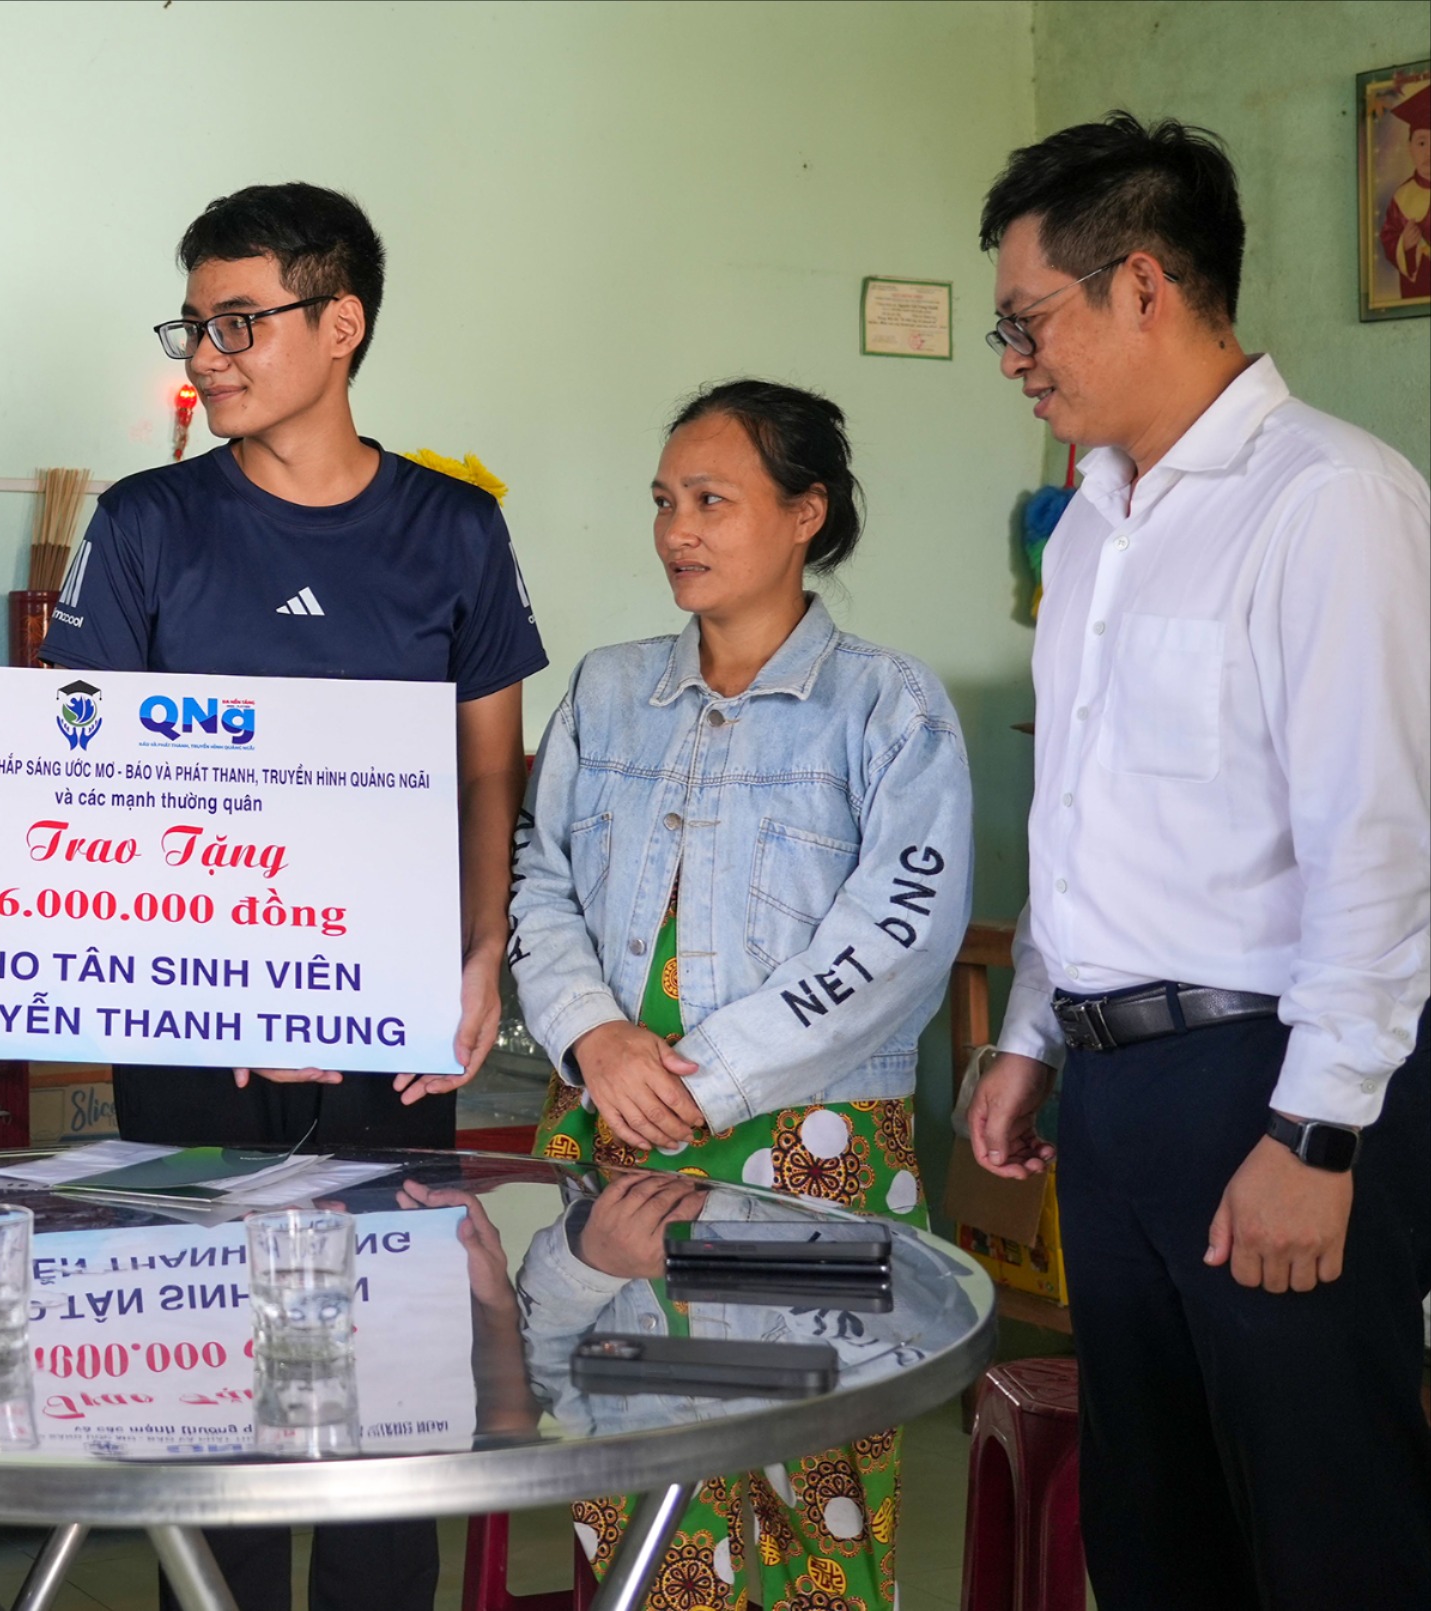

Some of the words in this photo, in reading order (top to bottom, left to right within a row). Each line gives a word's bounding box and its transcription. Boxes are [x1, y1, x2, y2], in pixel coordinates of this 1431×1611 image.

[139, 695, 255, 745] QNg
[25, 756, 62, 777] SÁNG
[65, 758, 92, 778] ƯỚC
[95, 761, 115, 779] MƠ
[125, 760, 153, 780] BÁO
[155, 761, 172, 781] VÀ
[175, 762, 209, 782] PHÁT
[212, 766, 259, 786] THANH,
[262, 763, 313, 786] TRUYỀN
[316, 766, 347, 787] HÌNH
[350, 765, 396, 789] QUẢNG
[399, 770, 430, 789] NGÃI
[54, 787, 73, 805] và
[78, 788, 106, 806] các
[111, 790, 156, 811] mạnh
[160, 791, 218, 815] thường
[222, 794, 263, 815] quân
[26, 819, 141, 865] Trao
[161, 824, 288, 879] Tặng
[231, 887, 348, 937] đồng
[780, 945, 874, 1028] NET
[874, 845, 945, 949] DNG
[52, 946, 135, 984] TÂN
[150, 955, 249, 988] SINH
[265, 953, 361, 992] VIÊN
[95, 1007, 241, 1042] THANH
[256, 1013, 406, 1047] TRUNG
